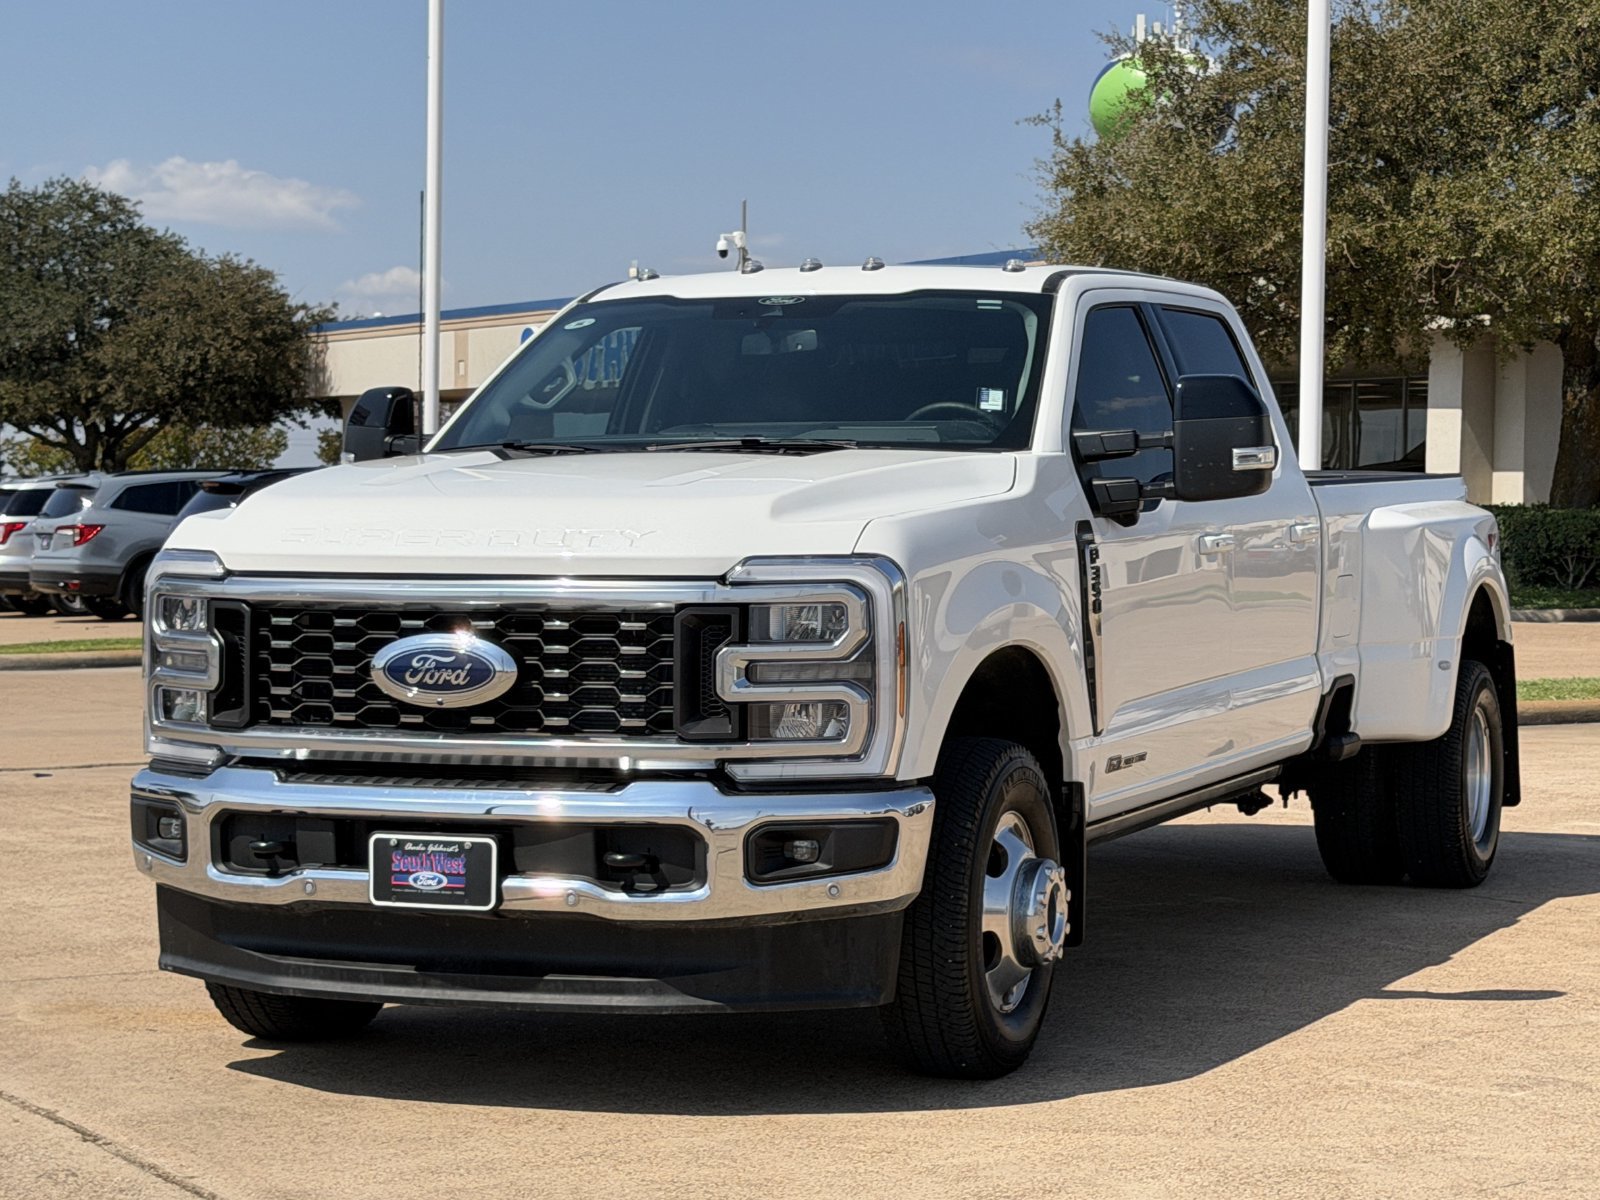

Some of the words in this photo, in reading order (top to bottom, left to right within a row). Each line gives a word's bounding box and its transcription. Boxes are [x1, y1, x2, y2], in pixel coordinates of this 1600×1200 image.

[280, 525, 478, 547] SUPER
[487, 527, 658, 548] DUTY
[404, 653, 472, 685] Ford
[416, 875, 438, 886] Ford
